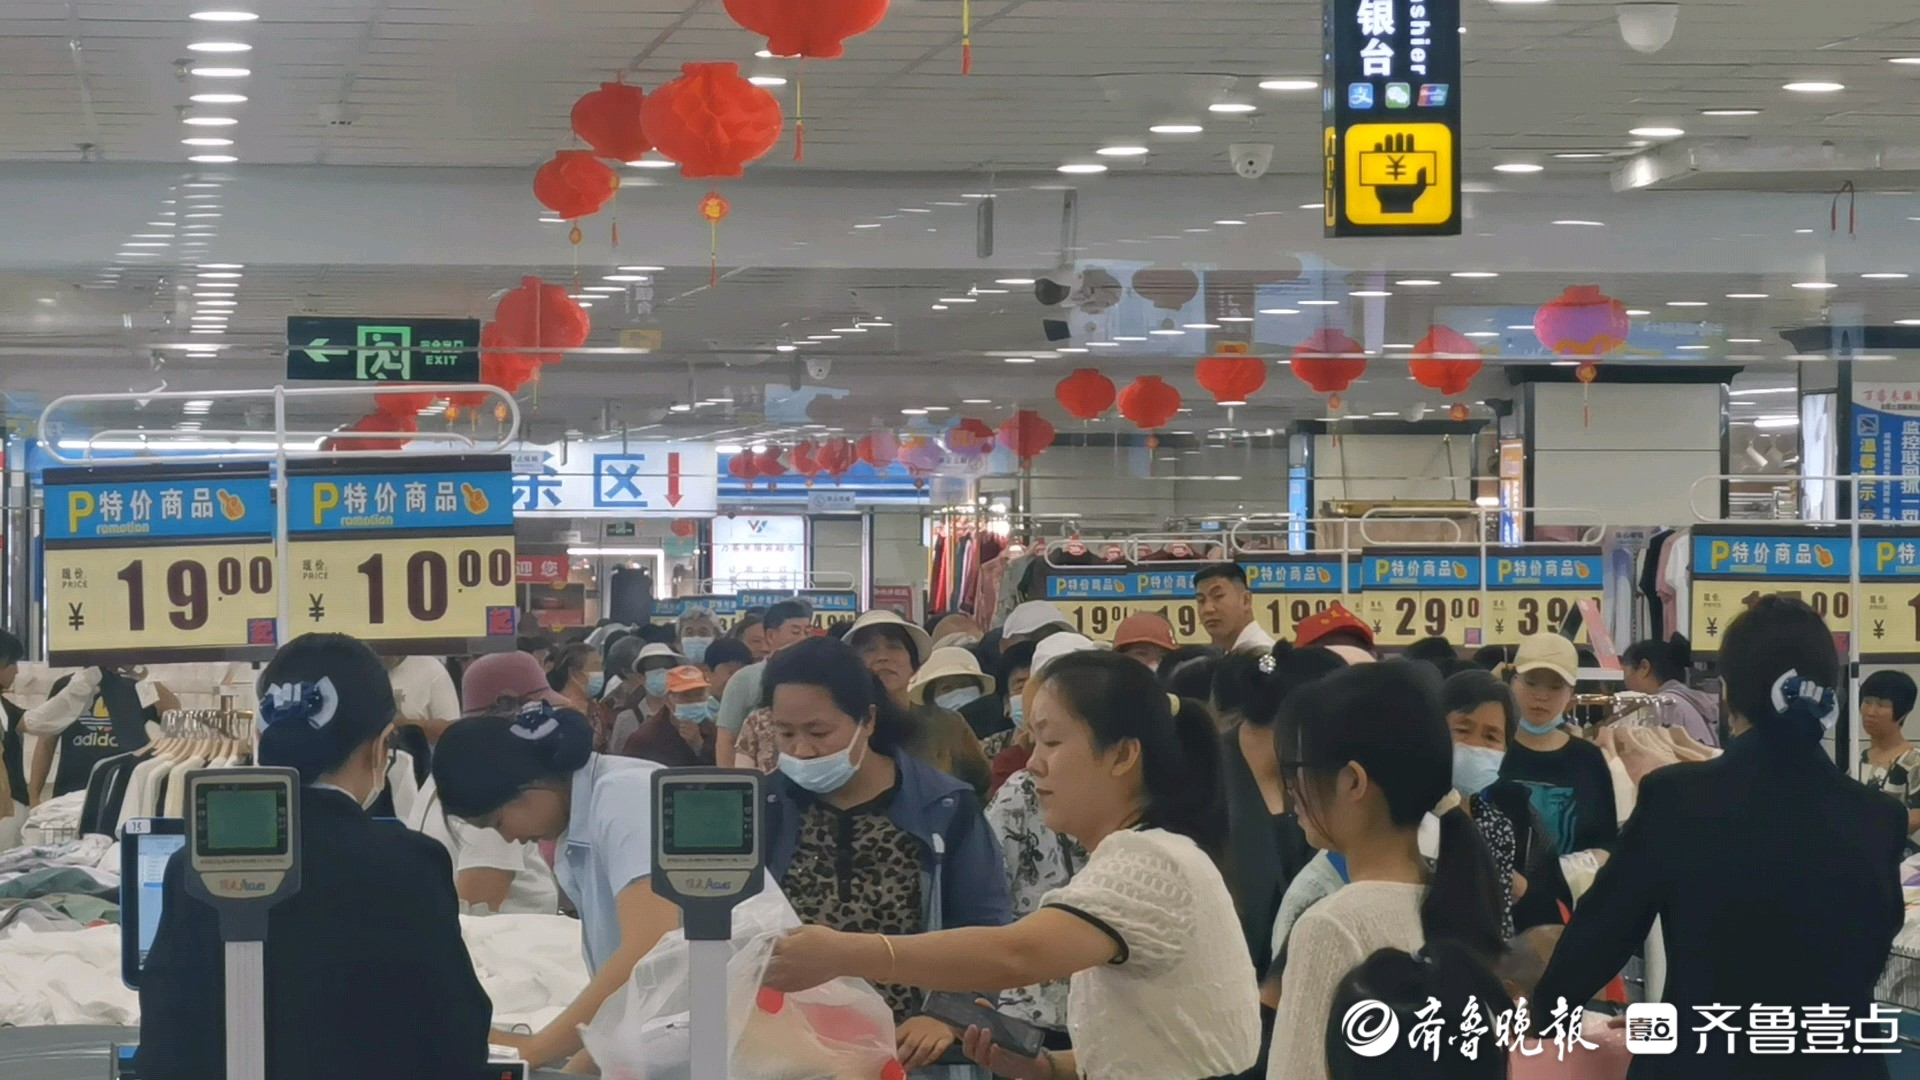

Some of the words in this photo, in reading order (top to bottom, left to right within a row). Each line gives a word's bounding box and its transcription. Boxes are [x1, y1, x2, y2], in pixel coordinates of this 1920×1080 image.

[1356, 0, 1396, 77] 银台
[1409, 0, 1431, 76] shier
[425, 355, 457, 365] EXIT
[99, 487, 215, 522] 特价商品
[343, 481, 458, 514] 特价商品
[1732, 541, 1812, 564] 特价商品
[302, 571, 329, 580] PRICE
[1260, 566, 1317, 582] 特价商品
[1391, 559, 1452, 577] 特价商品
[1513, 558, 1574, 577] 特价商品
[61, 580, 88, 589] PRICE
[117, 556, 273, 631] 19.00
[357, 548, 512, 624] 10.00
[1068, 578, 1114, 591] 特价商品
[68, 602, 85, 631] ¥
[308, 592, 325, 623] ¥
[1395, 597, 1480, 636] 29.00
[1706, 616, 1718, 637] ¥
